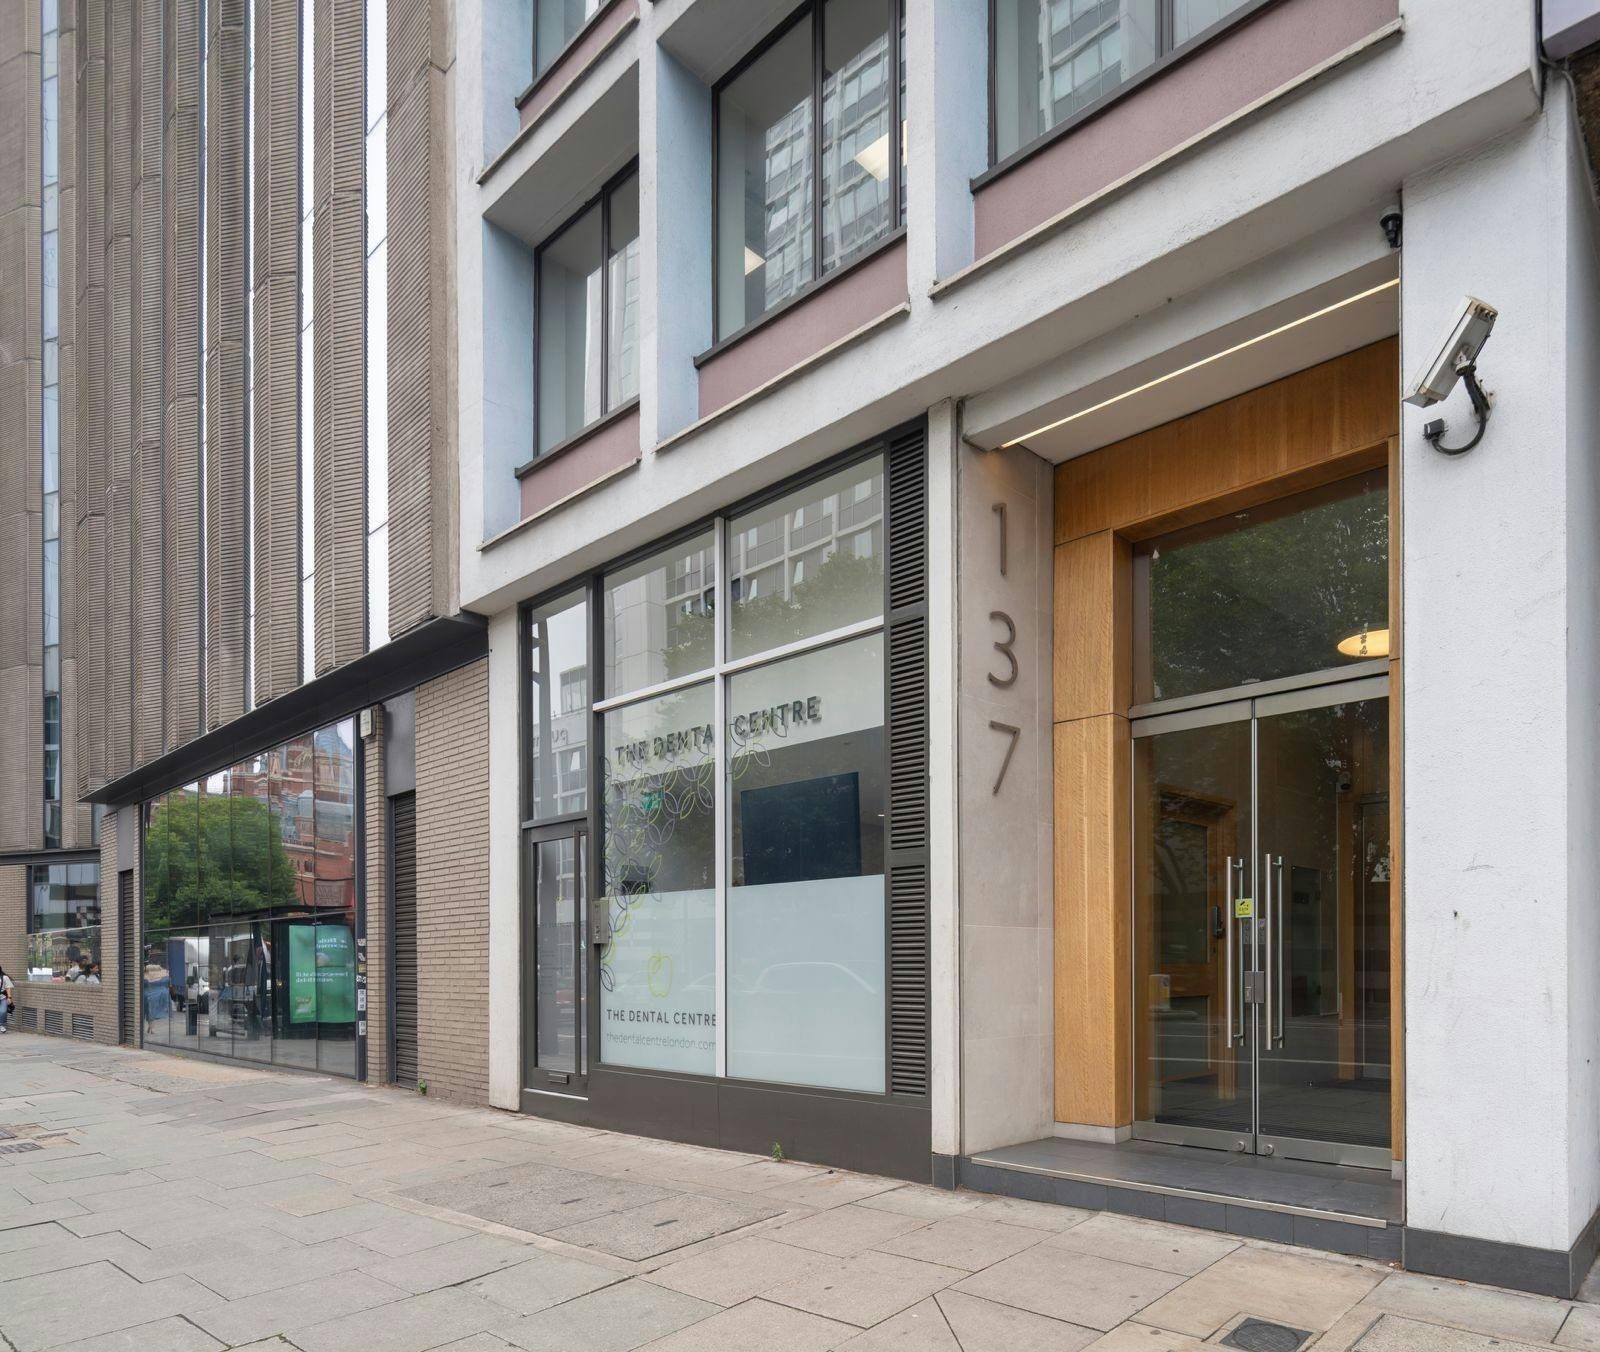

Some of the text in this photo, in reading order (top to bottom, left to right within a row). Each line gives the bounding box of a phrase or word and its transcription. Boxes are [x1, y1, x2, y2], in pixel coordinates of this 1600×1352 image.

[614, 695, 819, 765] THE DENTA CENTRE
[606, 1009, 716, 1026] THE DENTAL CENTRE
